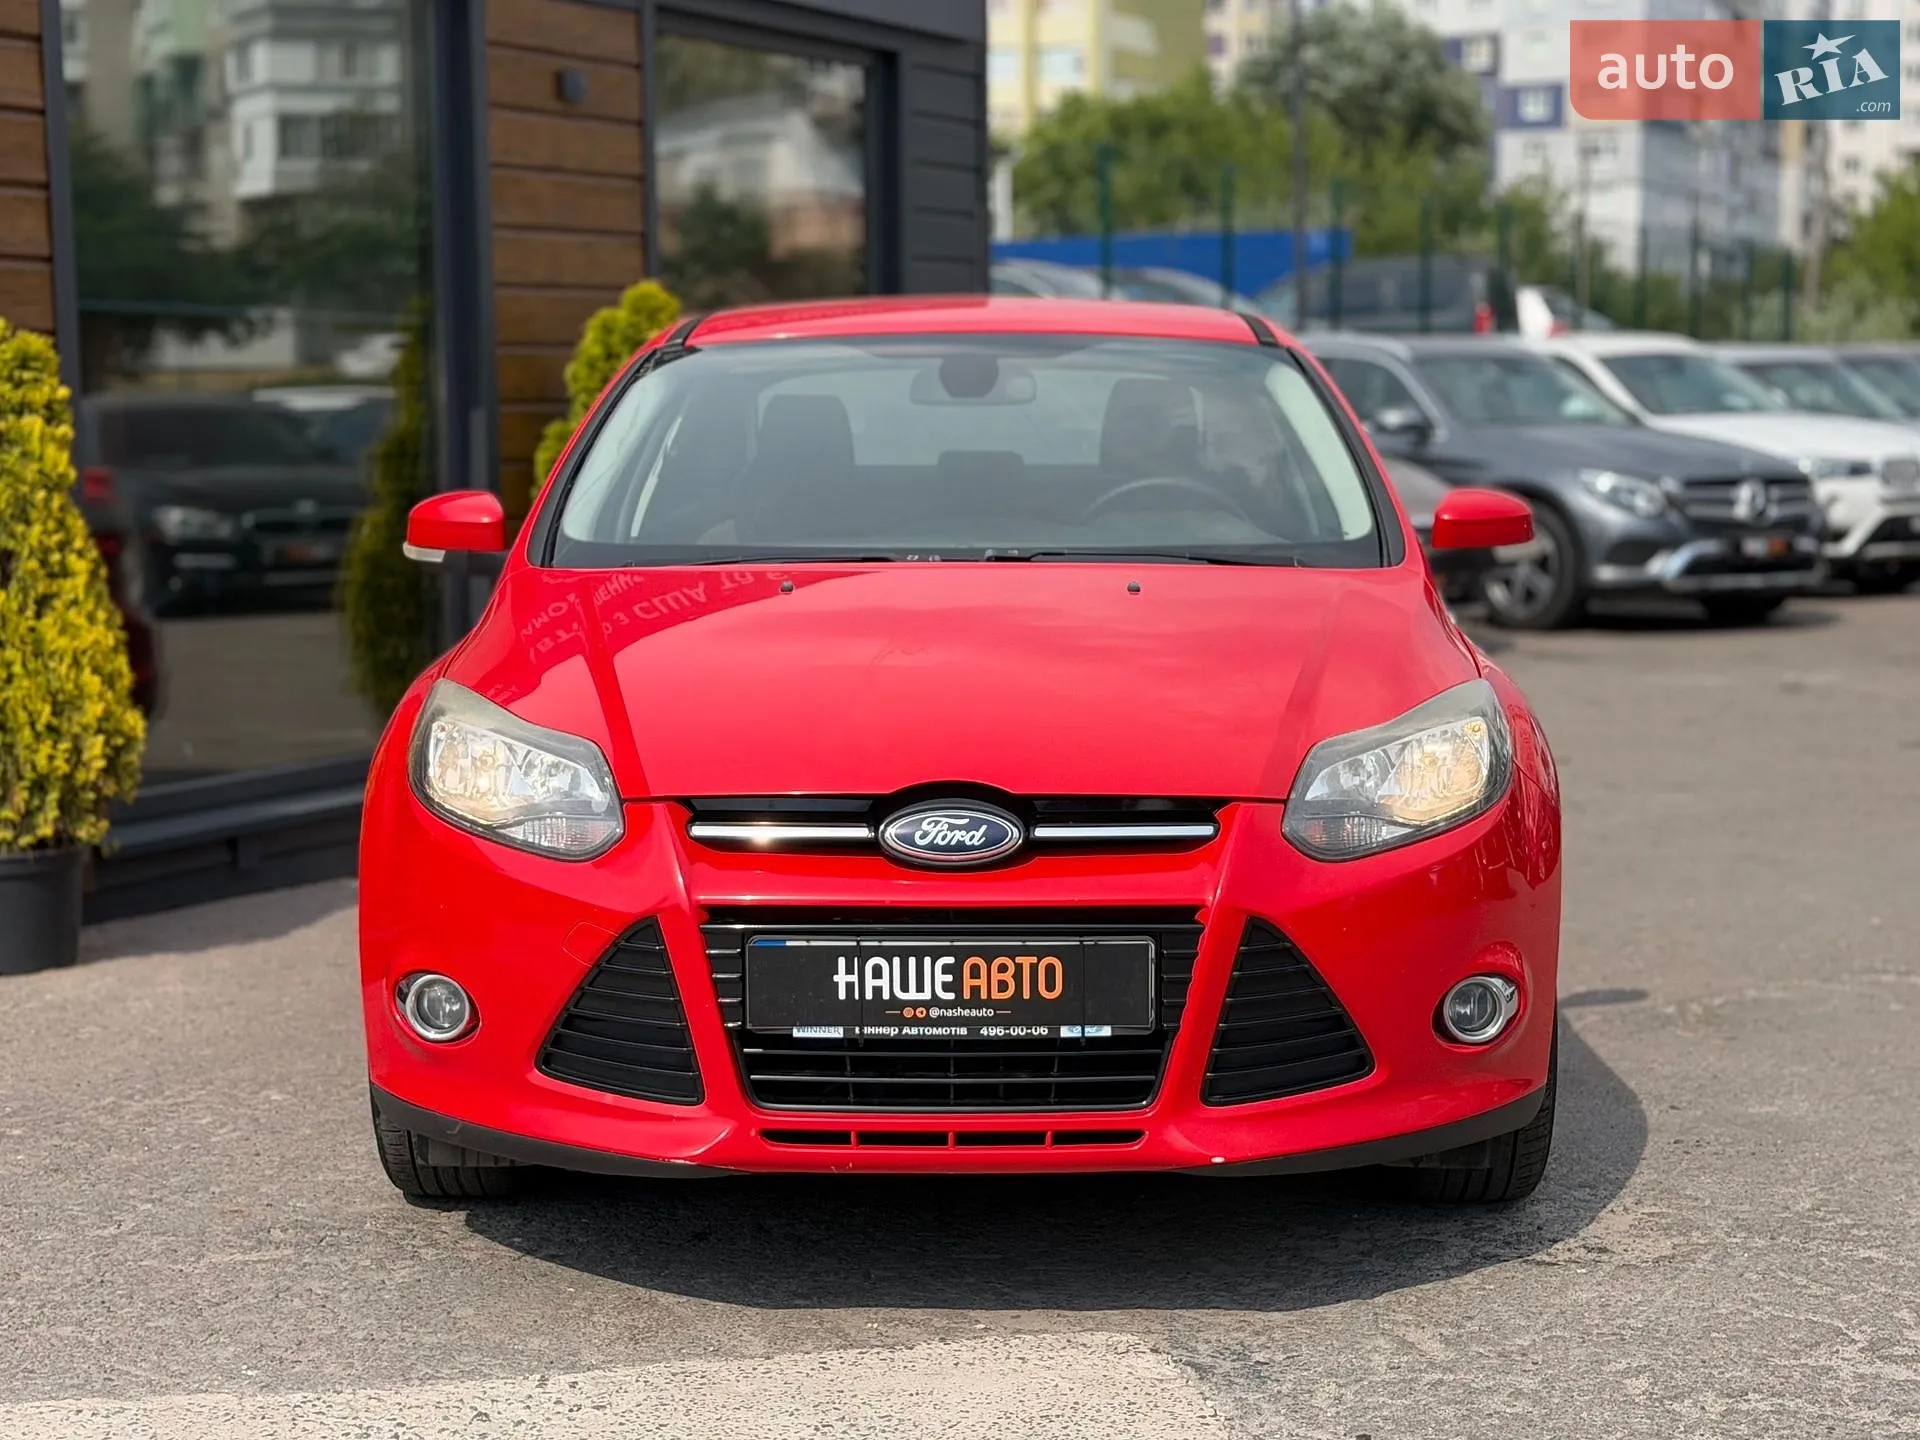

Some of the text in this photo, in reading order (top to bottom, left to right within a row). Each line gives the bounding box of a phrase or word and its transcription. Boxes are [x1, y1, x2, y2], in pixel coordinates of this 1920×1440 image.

[914, 816, 988, 846] Ford
[833, 955, 1064, 1000] НАШЕ АВТО
[929, 1005, 995, 1019] @nasheauto
[980, 1026, 1049, 1036] 496-00-06
